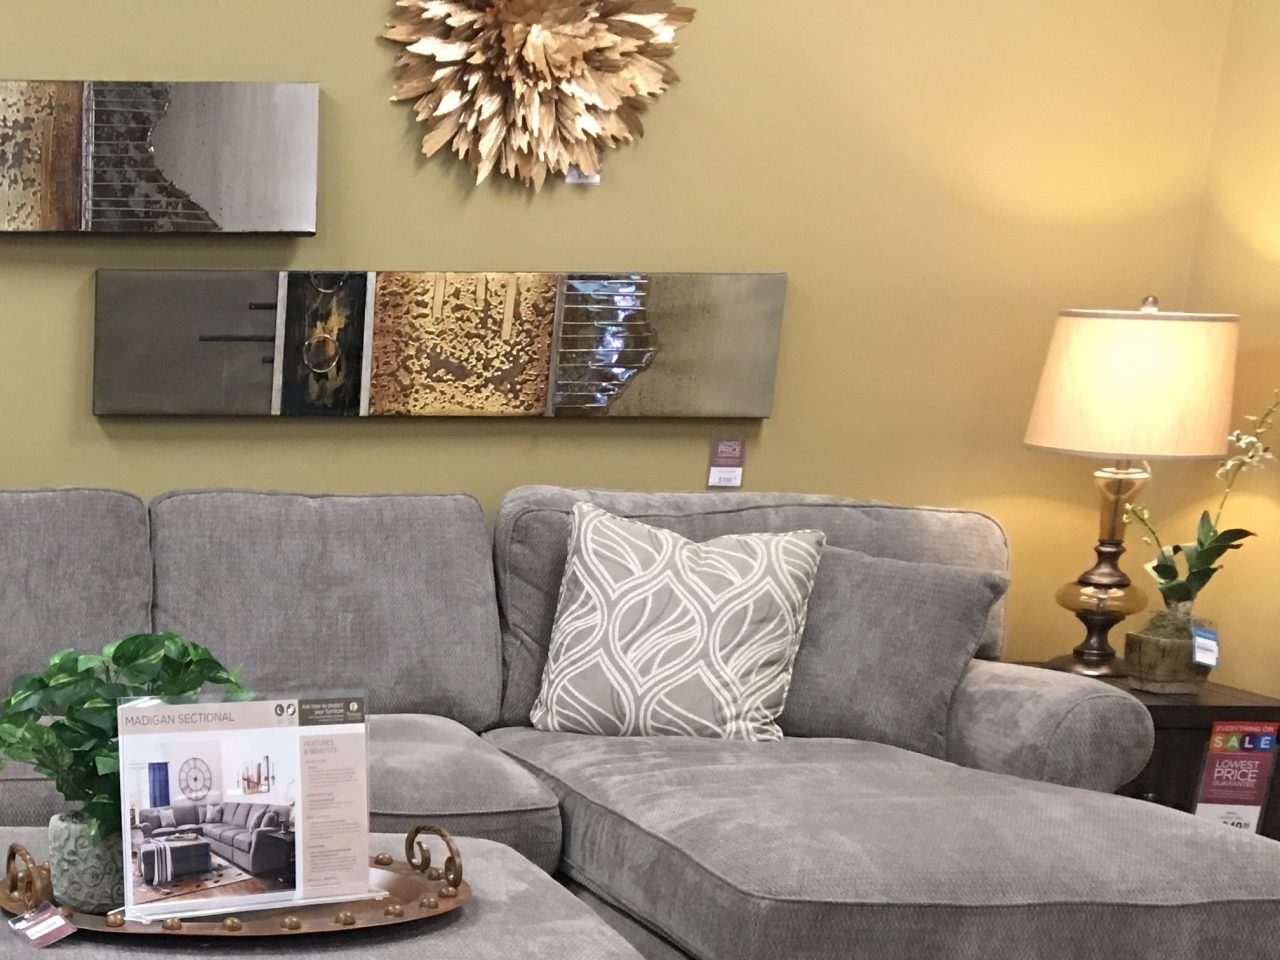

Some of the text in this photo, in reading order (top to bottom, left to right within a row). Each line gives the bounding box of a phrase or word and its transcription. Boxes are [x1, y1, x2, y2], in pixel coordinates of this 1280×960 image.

[124, 712, 235, 726] MADIGAN SECTIONAL
[1214, 735, 1273, 749] SALE
[1215, 759, 1261, 770] LOWEST
[1213, 769, 1259, 782] PRICE
